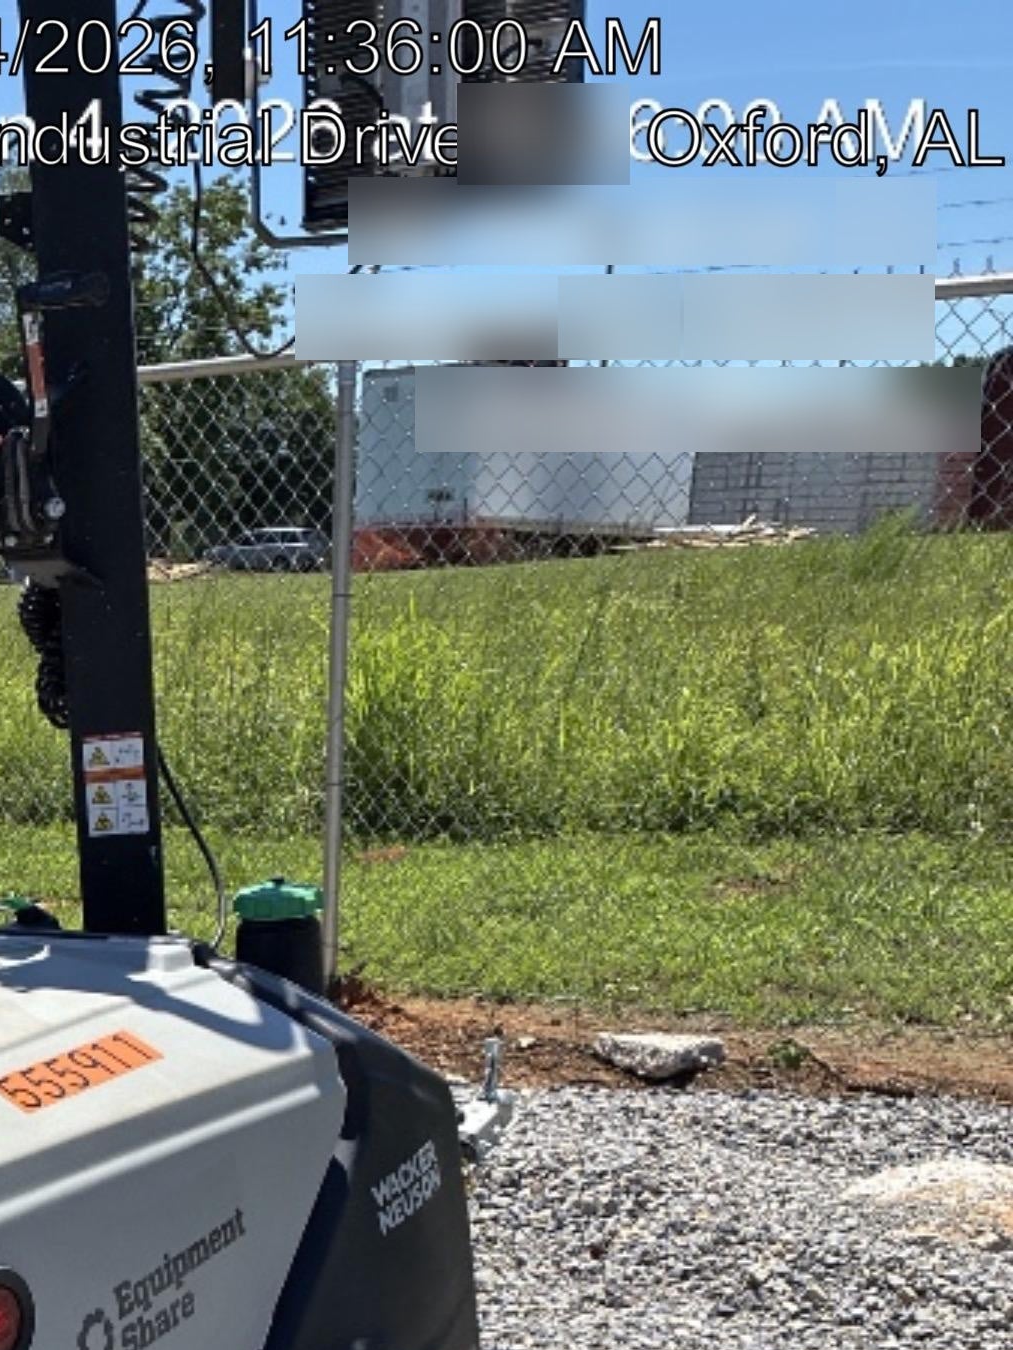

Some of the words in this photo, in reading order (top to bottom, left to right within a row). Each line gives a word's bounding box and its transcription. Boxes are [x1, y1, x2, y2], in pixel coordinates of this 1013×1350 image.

[370, 1139, 438, 1208] WACKER
[377, 1162, 441, 1237] NEUSON
[113, 1207, 246, 1321] Equipment
